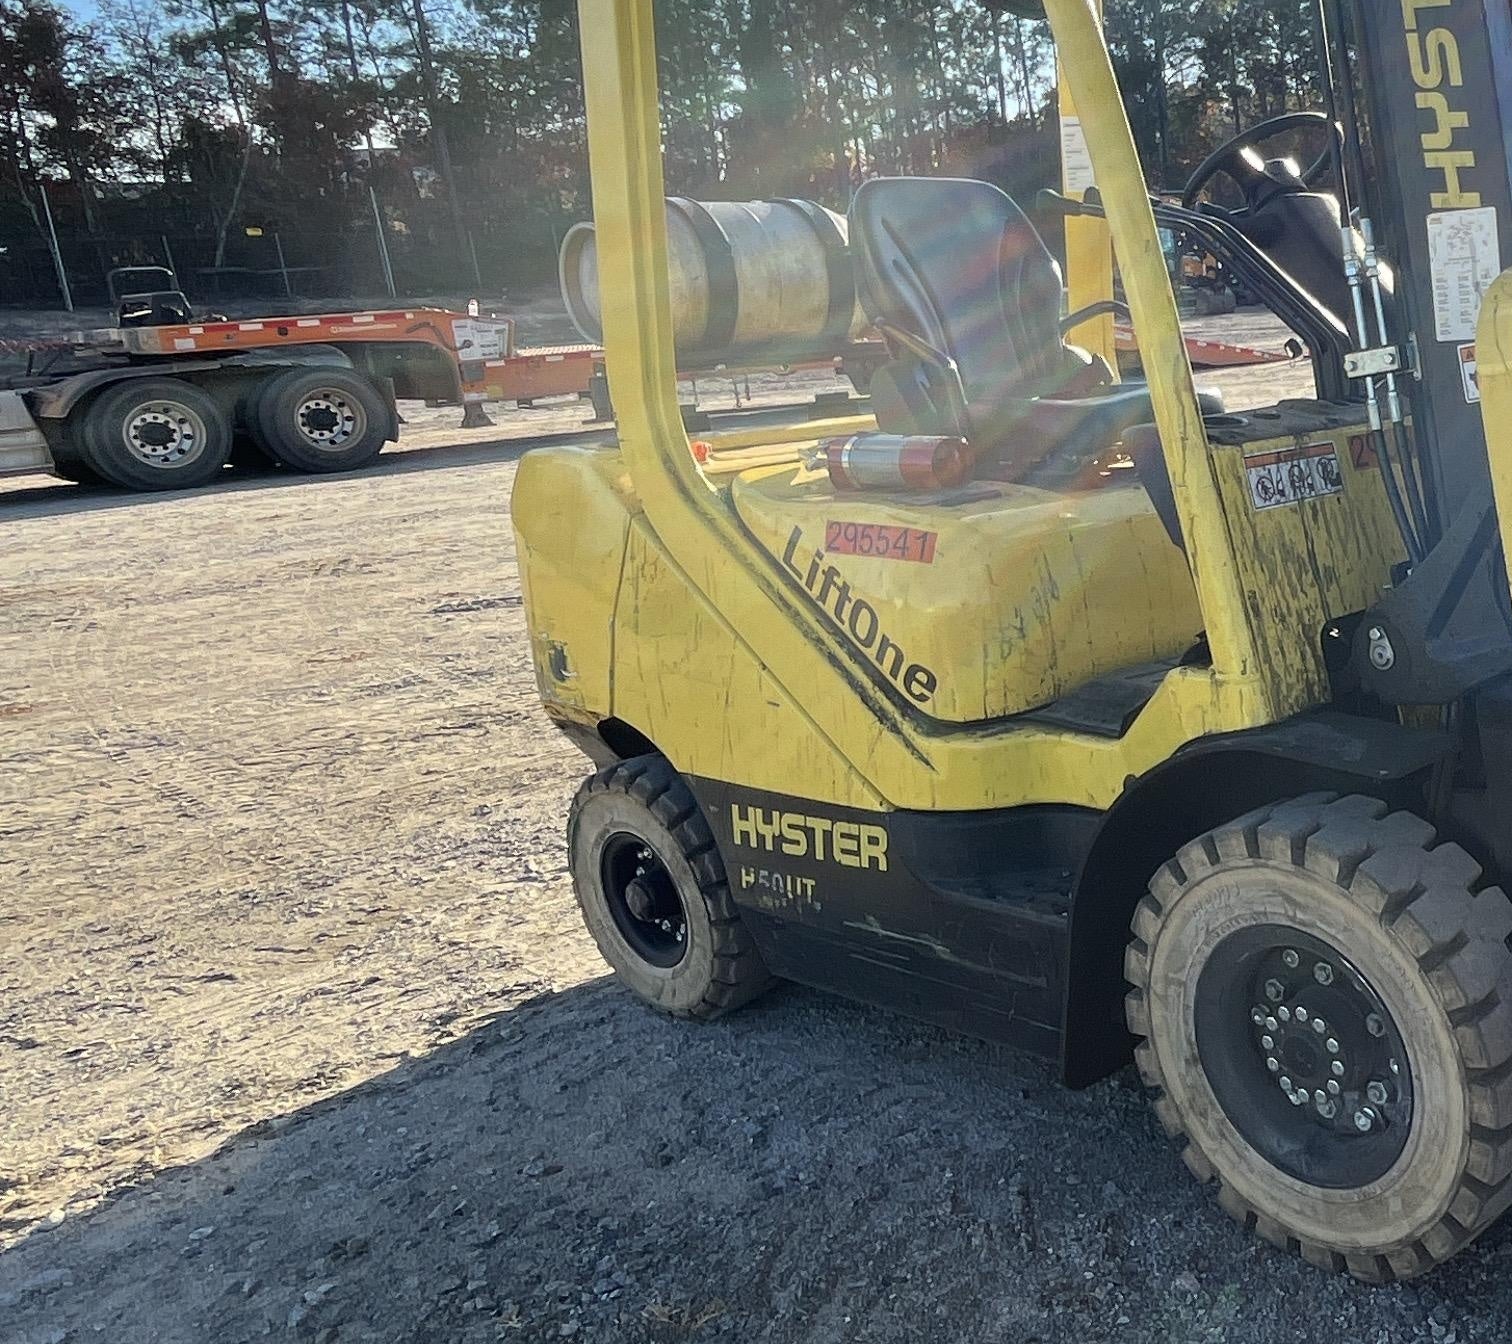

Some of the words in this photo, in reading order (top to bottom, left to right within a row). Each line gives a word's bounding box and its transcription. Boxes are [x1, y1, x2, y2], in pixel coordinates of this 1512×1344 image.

[827, 521, 929, 560] 295541
[783, 525, 937, 702] LiftOne
[731, 803, 889, 872] HYSTER
